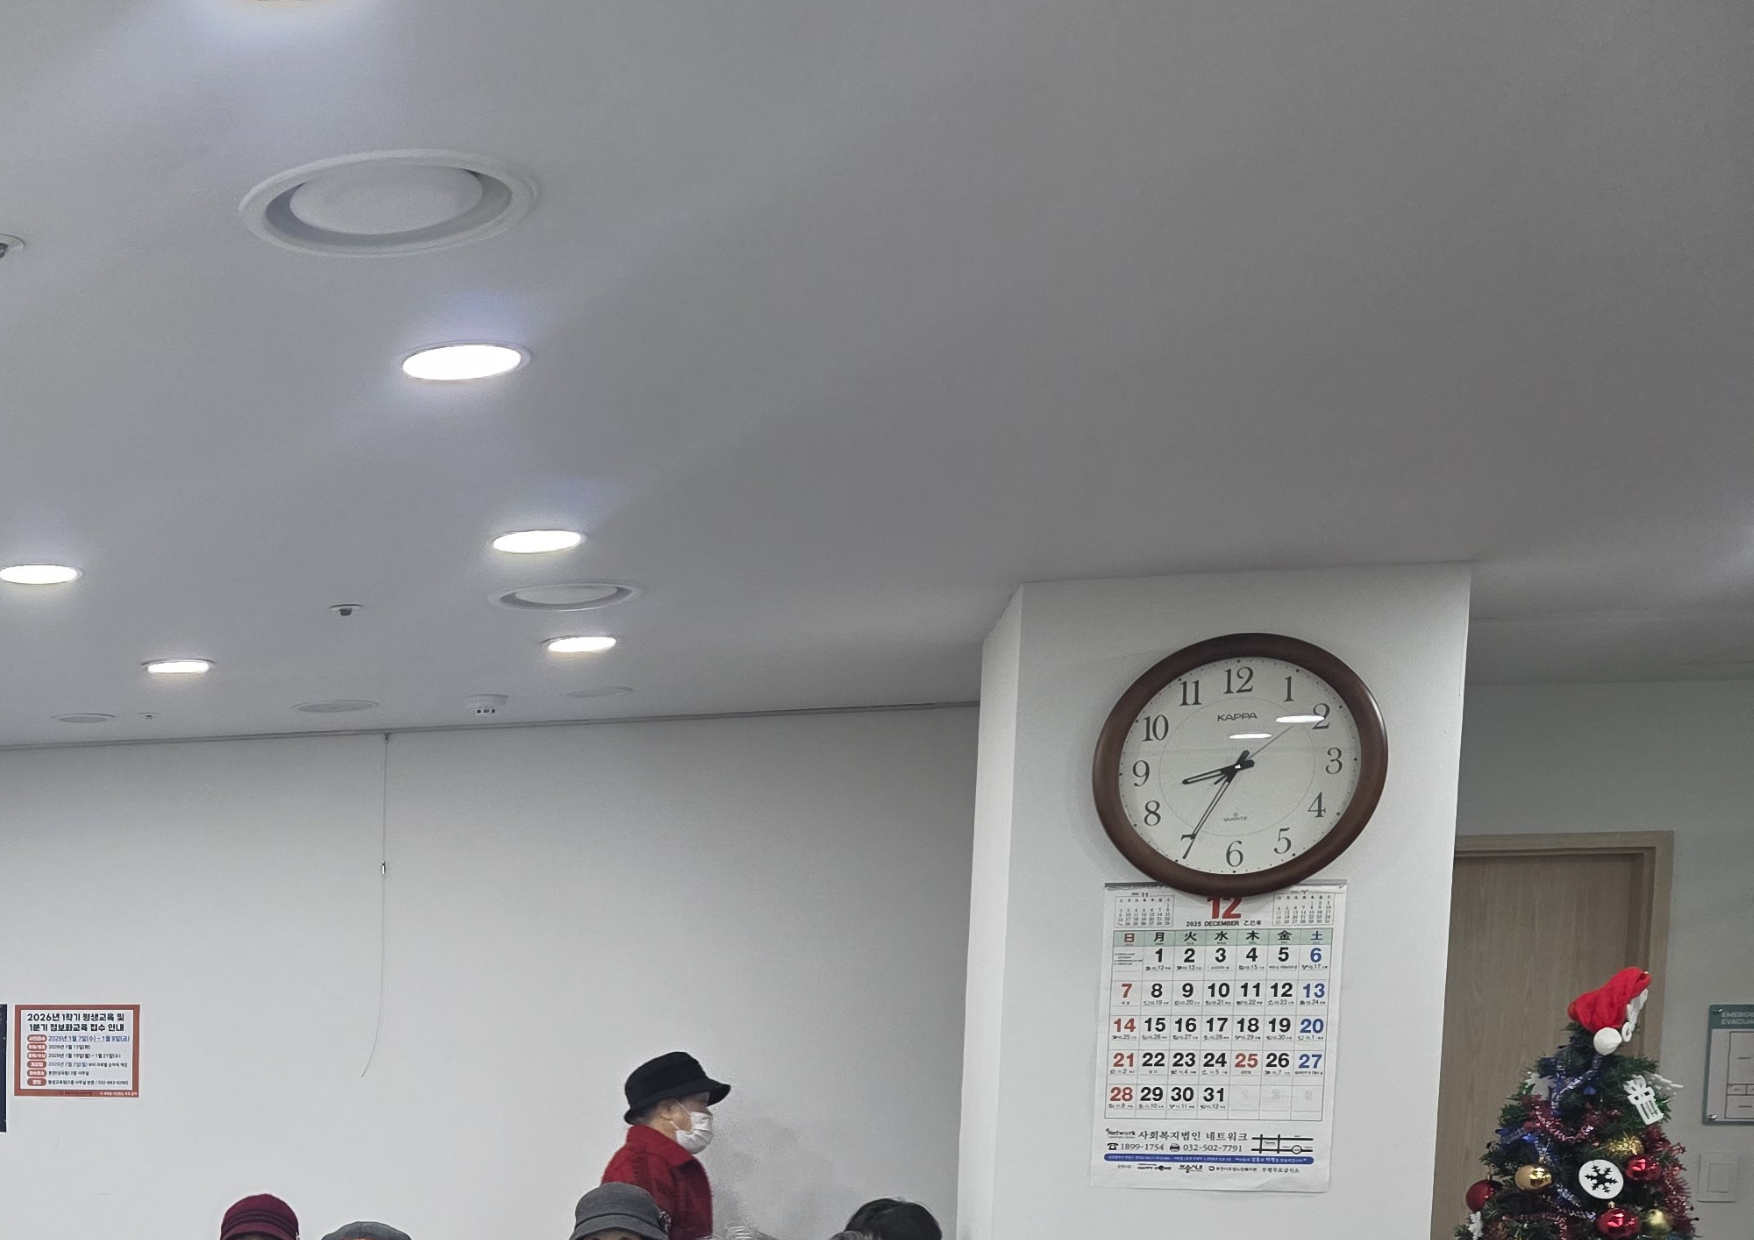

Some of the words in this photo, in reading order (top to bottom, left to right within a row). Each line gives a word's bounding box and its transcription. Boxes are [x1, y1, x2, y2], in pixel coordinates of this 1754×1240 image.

[1223, 666, 1254, 694] 12
[1283, 676, 1295, 702] 1
[1179, 680, 1202, 706] 11
[1142, 714, 1169, 742] 10
[1217, 711, 1258, 722] KAPPA
[1312, 703, 1331, 730] 2
[1325, 747, 1343, 775] 3
[1132, 760, 1151, 787] 9
[1144, 800, 1162, 827] 8
[1307, 792, 1327, 818] 4
[1180, 833, 1197, 860] 7
[1273, 827, 1292, 855] 5
[1226, 840, 1244, 867] 6
[1207, 896, 1243, 919] 12
[1124, 933, 1135, 943] 日
[1154, 932, 1165, 942] 月
[1184, 931, 1197, 942] 火
[1215, 930, 1229, 941] 水
[1246, 930, 1260, 941] 木
[1277, 929, 1292, 941] 金
[1310, 930, 1323, 941] 土
[1155, 948, 1163, 963] 1
[1183, 948, 1196, 963] 2
[1215, 948, 1227, 963] 3
[1246, 947, 1258, 962] 4
[1277, 947, 1290, 962] 5
[1310, 947, 1322, 963] 6
[1121, 983, 1133, 998] 7
[1151, 983, 1163, 998] 8
[1182, 983, 1194, 998] 9
[1207, 983, 1230, 998] 10
[1240, 982, 1261, 997] 11
[1270, 982, 1293, 998] 12
[1302, 983, 1325, 998] 13
[27, 1013, 60, 1022] 2026년
[62, 1013, 81, 1022] 1학기
[82, 1013, 114, 1022] 평생교육
[117, 1013, 125, 1022] 및
[29, 1024, 48, 1032] 1분기
[50, 1023, 88, 1032] 정보화교육
[90, 1023, 106, 1032] 접수
[108, 1023, 125, 1032] 안내
[1114, 1018, 1136, 1032] 14
[1144, 1017, 1166, 1032] 15
[1174, 1017, 1197, 1032] 16
[1206, 1017, 1229, 1032] 17
[1237, 1017, 1259, 1033] 18
[1268, 1017, 1291, 1033] 19
[1300, 1018, 1324, 1034] 20
[1113, 1052, 1134, 1067] 21
[1142, 1052, 1165, 1067] 22
[1172, 1052, 1196, 1067] 23
[1203, 1053, 1227, 1067] 24
[1234, 1053, 1258, 1068] 25
[1266, 1053, 1290, 1068] 26
[1298, 1054, 1322, 1069] 27
[1110, 1087, 1133, 1101] 28
[1140, 1086, 1164, 1101] 29
[1171, 1087, 1194, 1101] 30
[1203, 1087, 1224, 1102] 31
[1120, 1143, 1164, 1151] 1899-1754
[1183, 1144, 1242, 1152] 032-502-7791
[1138, 1130, 1201, 1141] 사회복지법인
[1206, 1131, 1248, 1142] 네트워크
